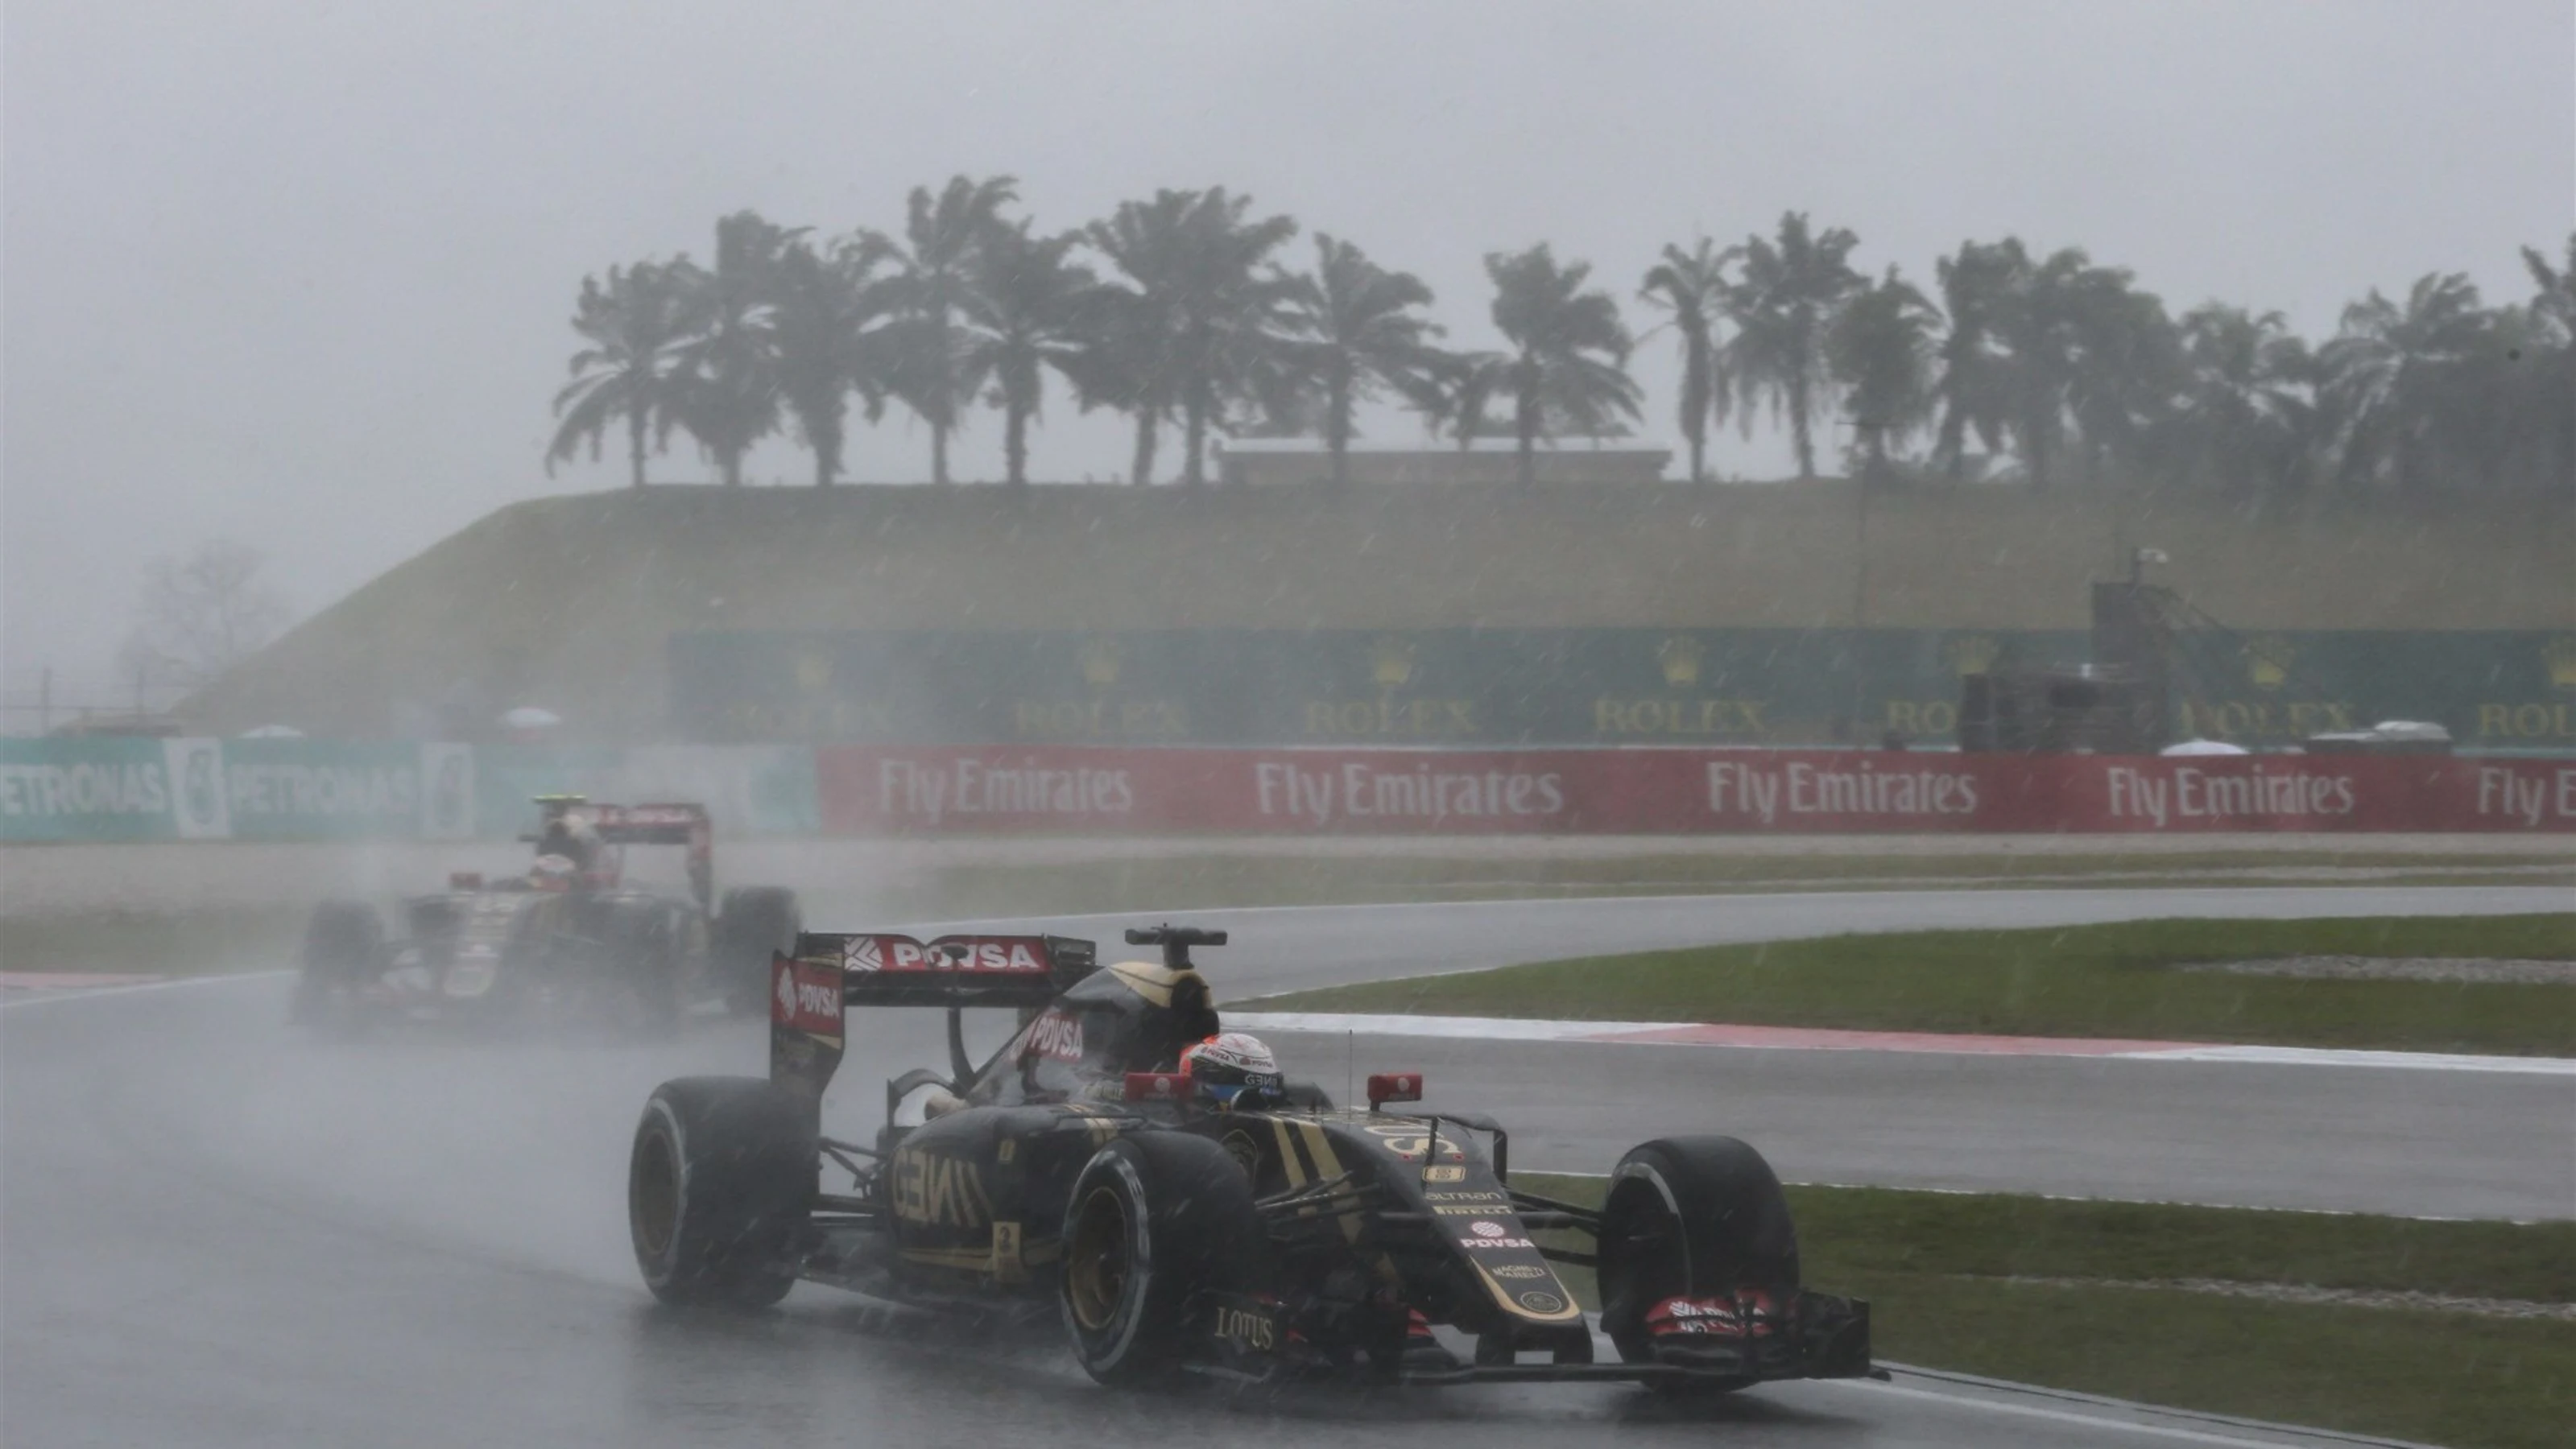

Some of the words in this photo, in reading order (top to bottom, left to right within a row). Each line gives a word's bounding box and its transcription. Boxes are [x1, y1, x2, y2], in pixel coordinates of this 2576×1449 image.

[1305, 700, 1475, 733] ROLEX
[1594, 700, 1768, 733] ROLEX
[1887, 700, 1958, 733] RO
[879, 758, 947, 823] Fly
[955, 756, 1133, 813] Emirates
[1255, 762, 1332, 824] Fly
[1343, 762, 1564, 815] Emirates
[1706, 761, 1778, 824] Fly
[1786, 760, 1979, 814] Emirates
[2107, 766, 2168, 828] Fly
[2175, 763, 2355, 816] Emirates
[2479, 767, 2546, 827] Fly
[799, 982, 840, 1018] PDVSA
[1031, 1016, 1083, 1058] PDVSA
[1459, 1238, 1536, 1248] PDVSA
[1214, 1306, 1274, 1350] LOTUS
